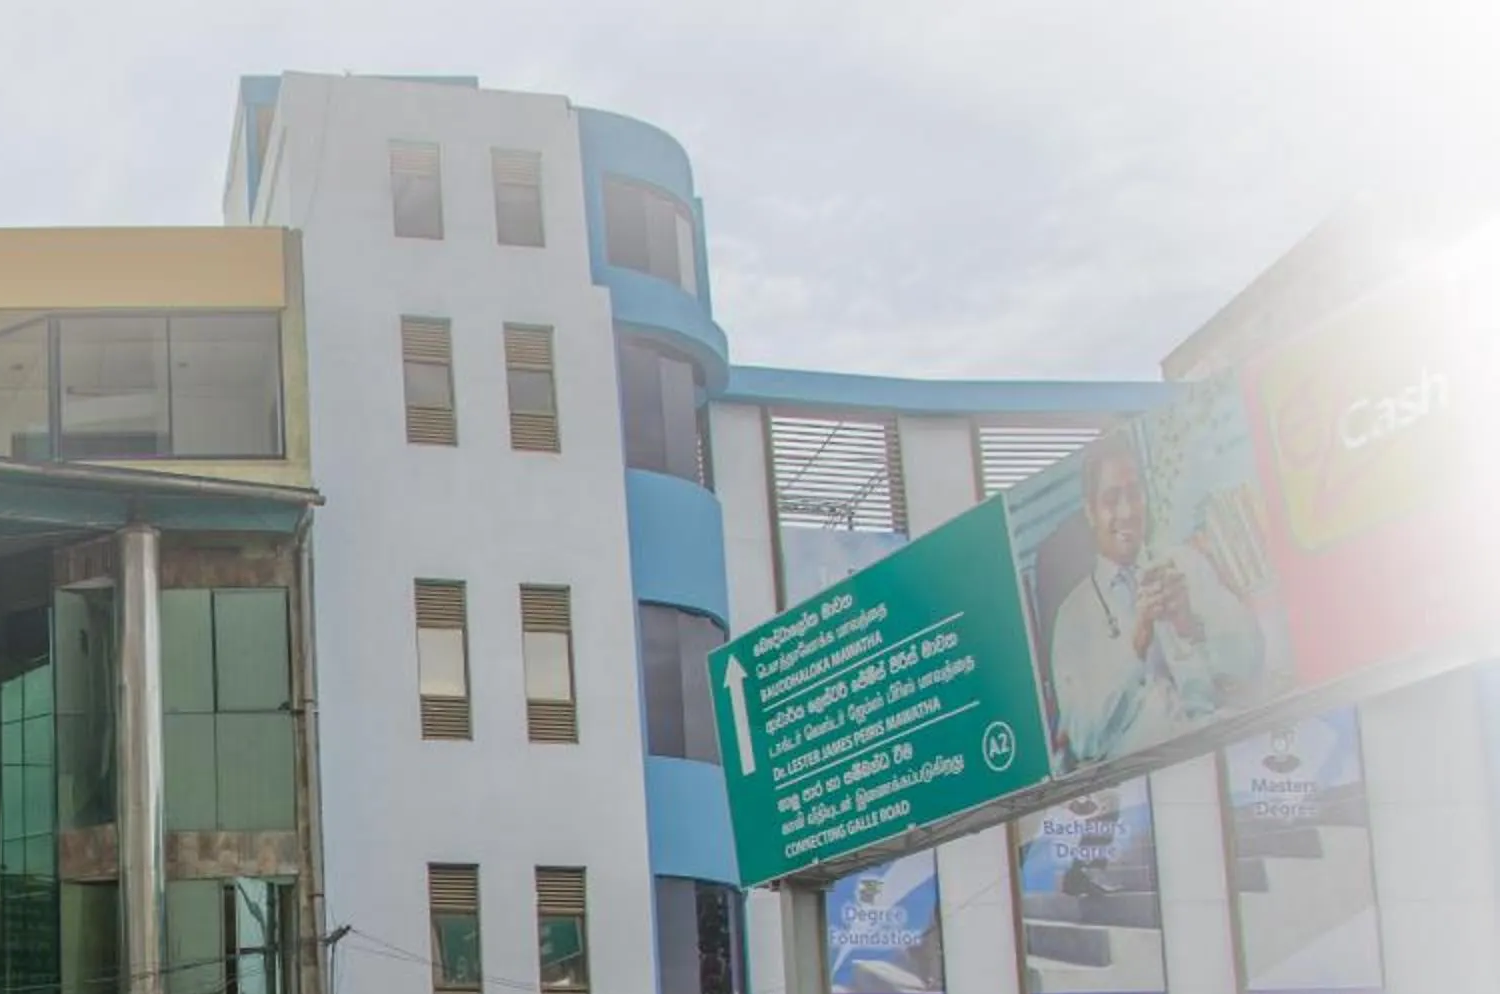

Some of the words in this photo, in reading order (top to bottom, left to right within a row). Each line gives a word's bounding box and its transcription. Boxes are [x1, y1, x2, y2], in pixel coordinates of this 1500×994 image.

[1339, 365, 1449, 449] Cash
[831, 631, 882, 666] MAWATHA
[787, 750, 820, 774] LESTER
[820, 735, 852, 759] JAMES
[886, 698, 940, 729] MAWATHA
[989, 733, 1009, 756] A2
[1252, 778, 1316, 794] Masters
[785, 824, 846, 856] CONNECTING
[846, 812, 878, 834] GALLE
[880, 800, 909, 821] ROAD
[1043, 820, 1127, 836] Bachelors
[1056, 843, 1118, 861] Degree
[844, 906, 907, 924] Degree
[830, 929, 921, 946] Foundation
